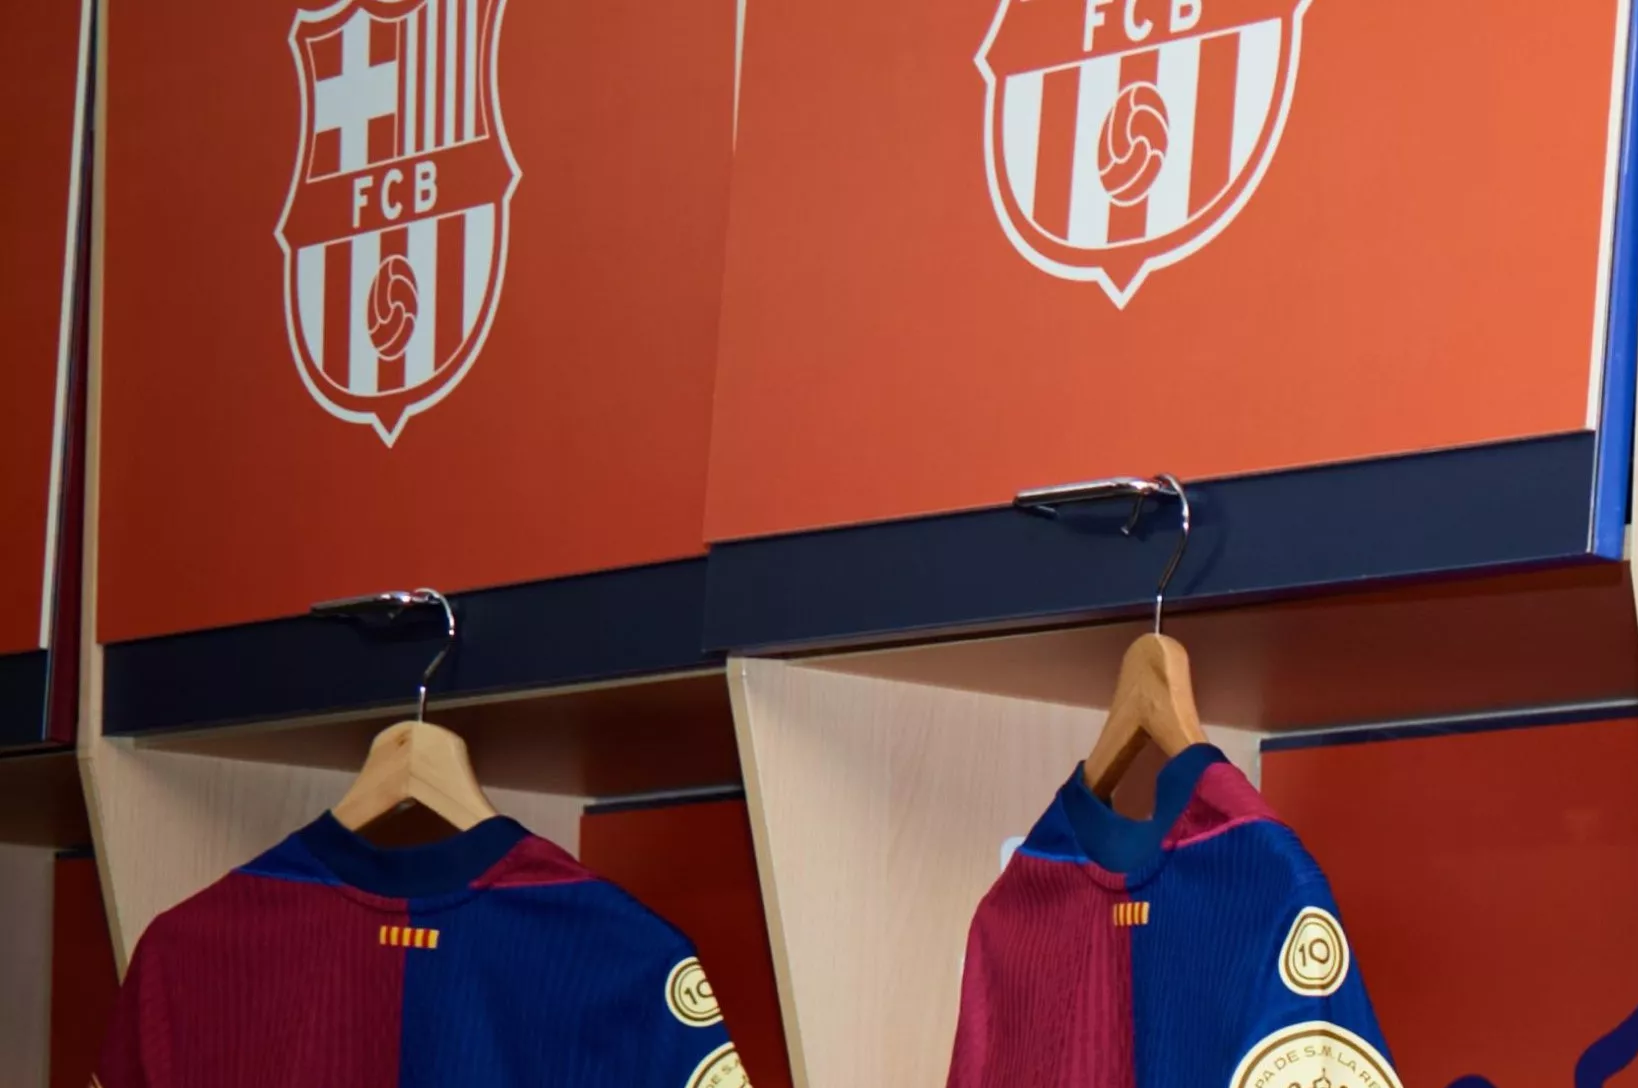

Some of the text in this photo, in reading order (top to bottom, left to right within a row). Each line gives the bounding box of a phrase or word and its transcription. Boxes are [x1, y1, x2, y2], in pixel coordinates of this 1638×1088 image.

[352, 160, 438, 229] FCB
[1298, 938, 1331, 968] 10
[1274, 1050, 1301, 1071] DE
[1337, 1051, 1357, 1074] LA
